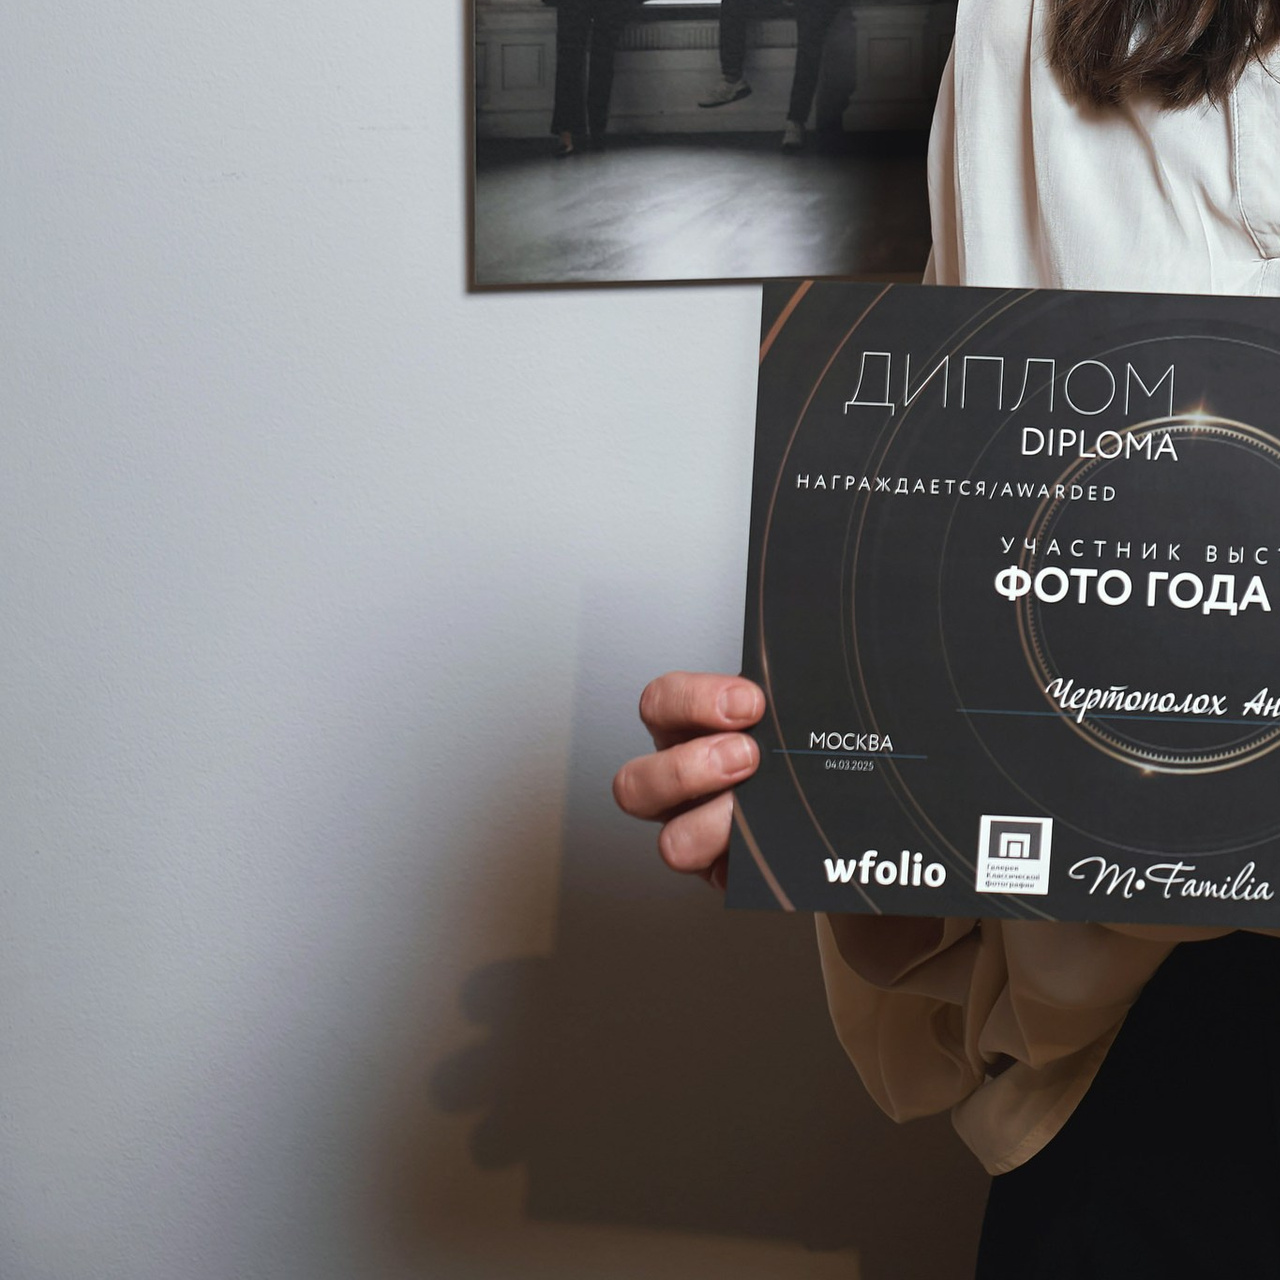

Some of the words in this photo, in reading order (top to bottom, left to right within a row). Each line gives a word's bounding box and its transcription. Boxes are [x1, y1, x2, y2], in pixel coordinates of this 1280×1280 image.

[844, 351, 1175, 417] ДИПЛОМ
[1021, 427, 1179, 461] DIPLOMA
[1001, 536, 1181, 561] УЧАСТНИК
[994, 565, 1133, 607] ФОТО
[1147, 571, 1272, 617] ГОДА
[1044, 677, 1228, 724] Чертополох
[809, 731, 894, 752] МОСКВА
[825, 758, 875, 772] 04.03.2025
[824, 849, 947, 887] wfolio
